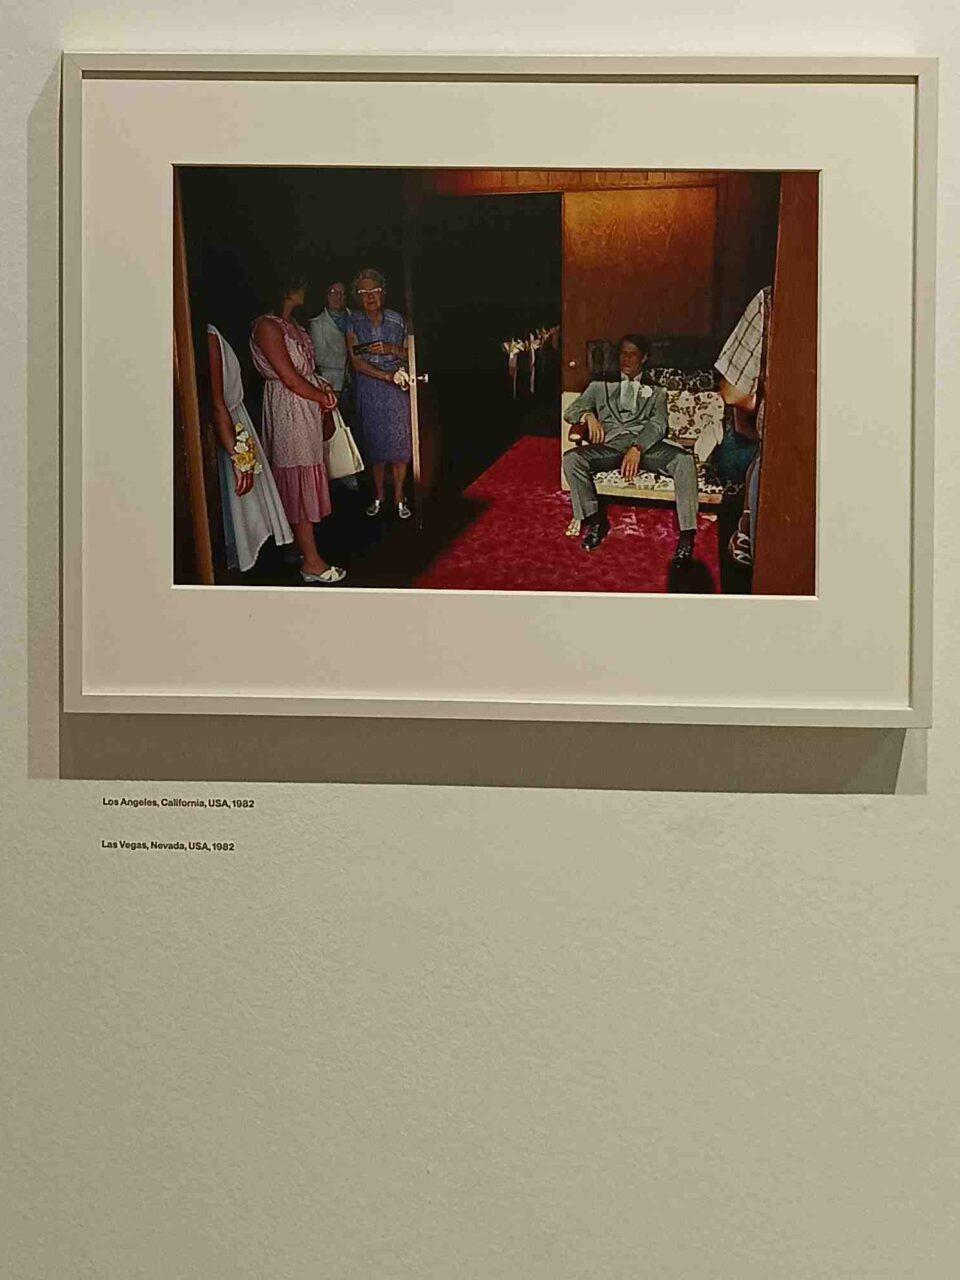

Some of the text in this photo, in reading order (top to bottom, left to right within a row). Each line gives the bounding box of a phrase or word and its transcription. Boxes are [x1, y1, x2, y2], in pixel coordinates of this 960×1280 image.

[103, 797, 255, 809] Los Angeles, California, USA, 1982
[101, 840, 235, 852] Las Vegas, Nevada, USA, 1982
